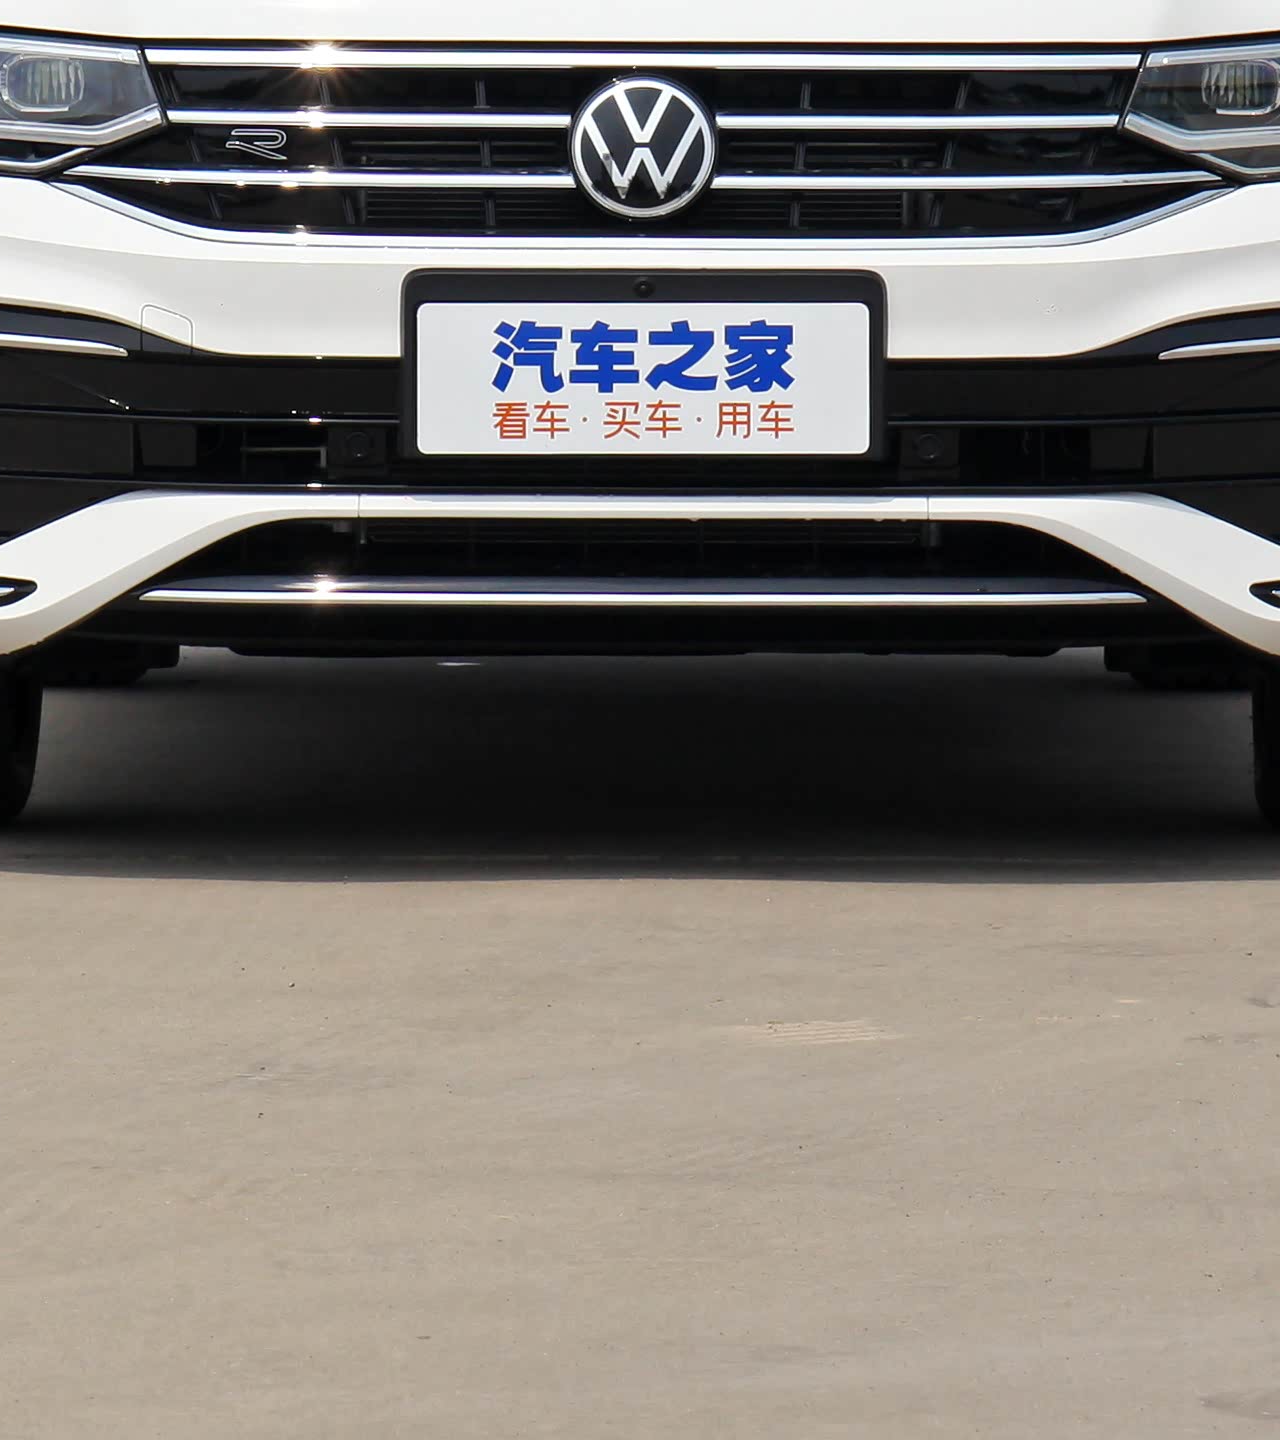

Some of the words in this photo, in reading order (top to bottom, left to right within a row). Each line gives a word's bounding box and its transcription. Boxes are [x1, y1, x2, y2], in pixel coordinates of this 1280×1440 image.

[491, 319, 796, 394] 汽车之家
[491, 400, 796, 440] 看车·买车·用车
